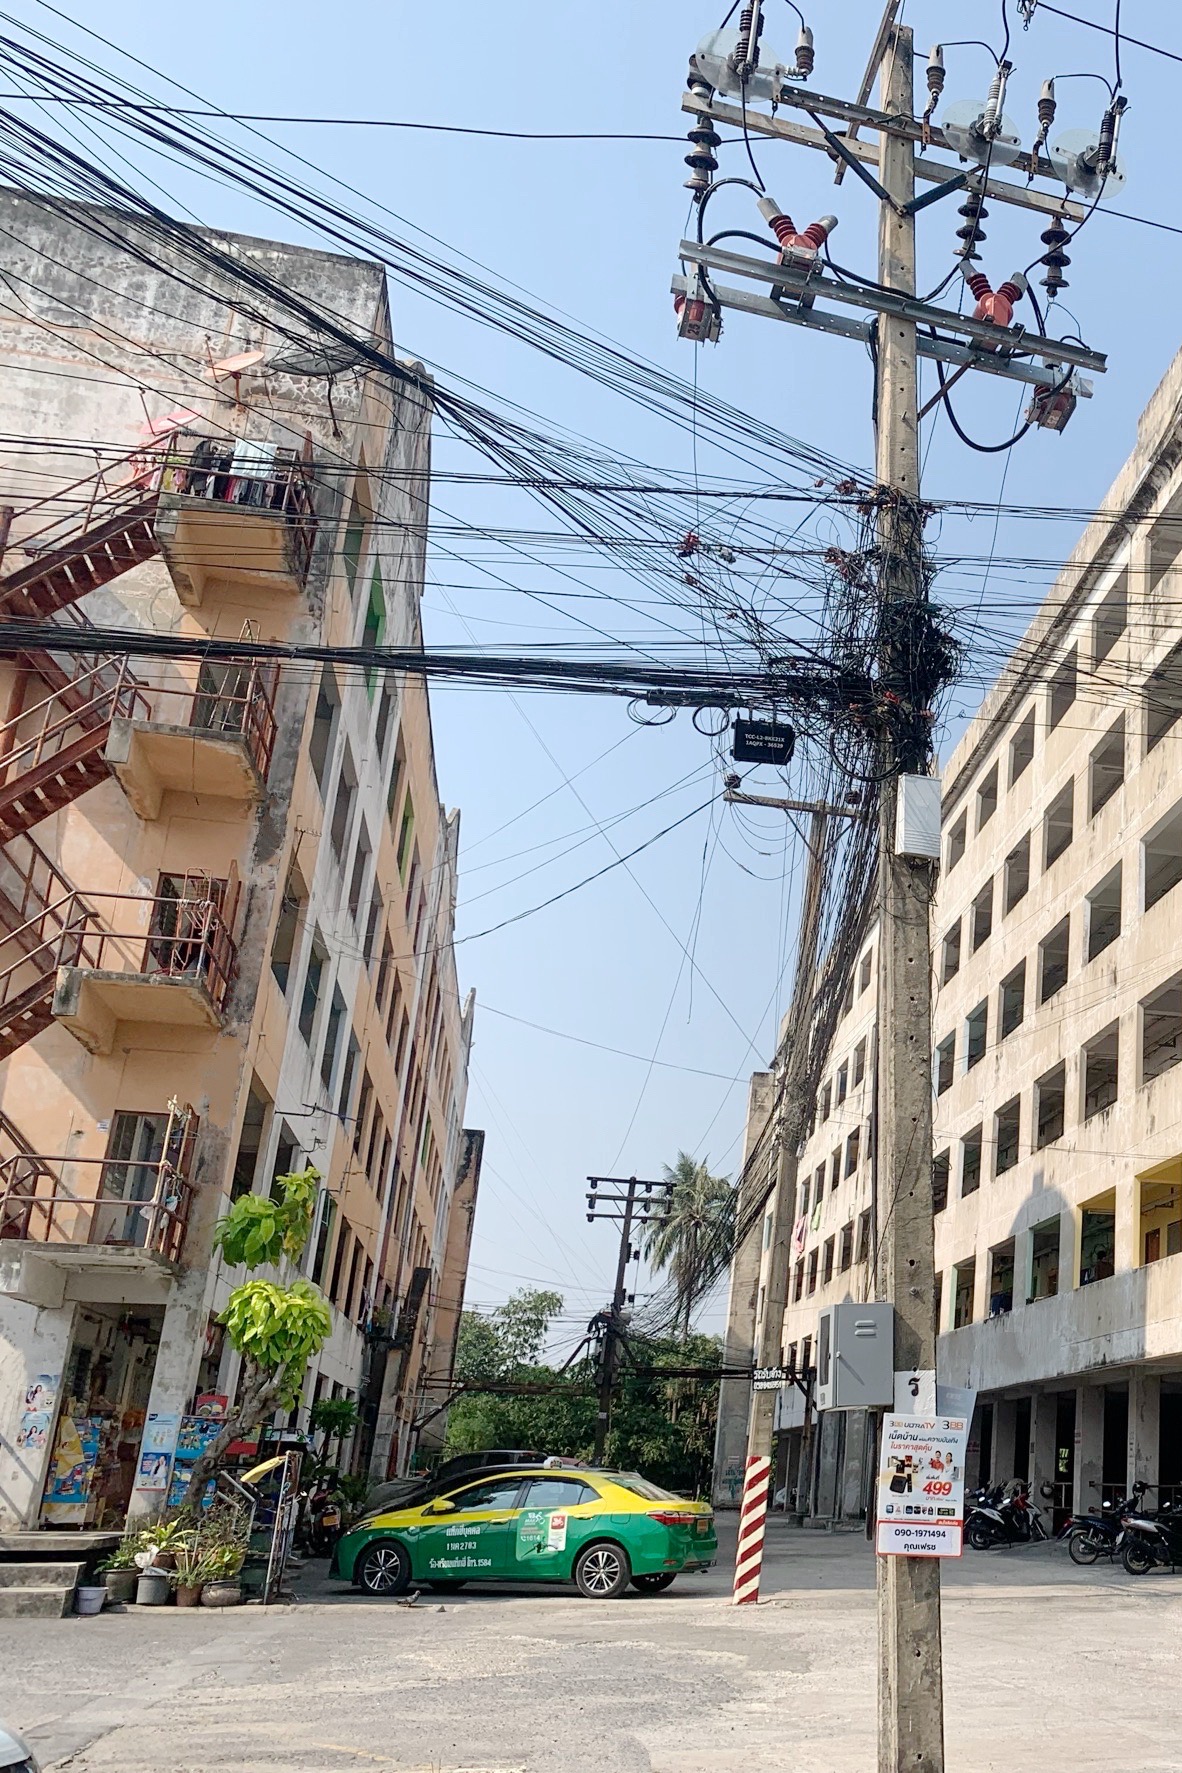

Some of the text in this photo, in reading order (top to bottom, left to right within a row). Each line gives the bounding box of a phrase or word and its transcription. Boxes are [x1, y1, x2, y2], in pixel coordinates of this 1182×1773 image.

[942, 1420, 963, 1431] 3BB
[922, 1481, 952, 1496] 499
[894, 1529, 946, 1537] 090-1971494
